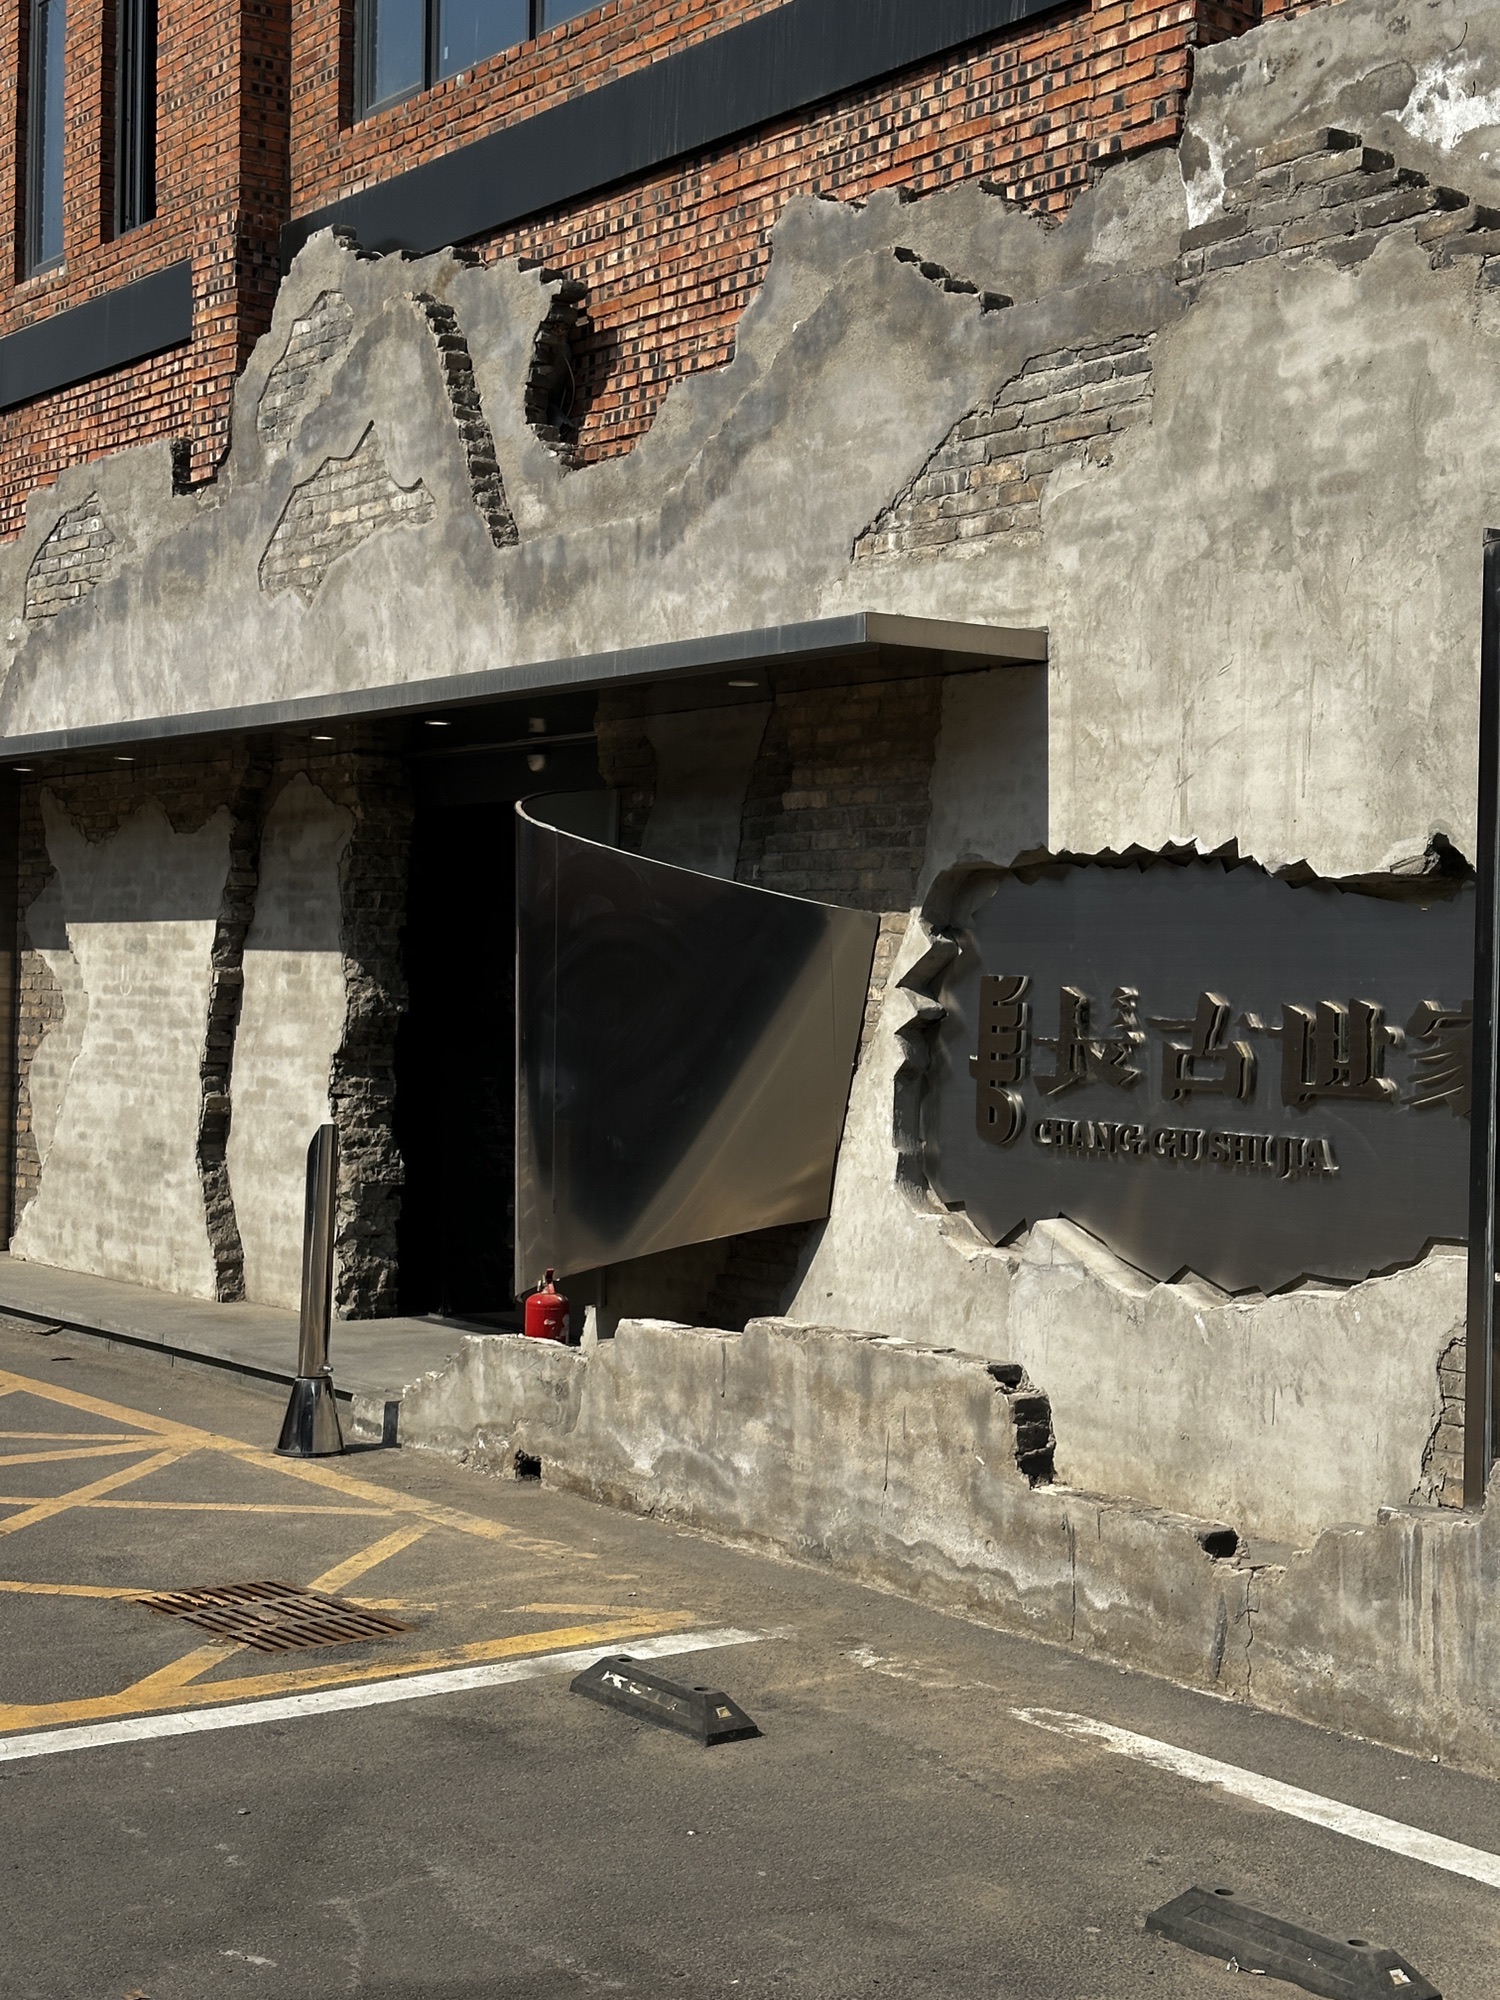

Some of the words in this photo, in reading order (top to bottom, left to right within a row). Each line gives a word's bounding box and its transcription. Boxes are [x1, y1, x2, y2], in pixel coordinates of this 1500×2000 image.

[1032, 1118, 1147, 1155] CHANG
[1151, 1127, 1205, 1161] GU
[1209, 1131, 1273, 1167] SHI
[1276, 1136, 1340, 1180] JIA
